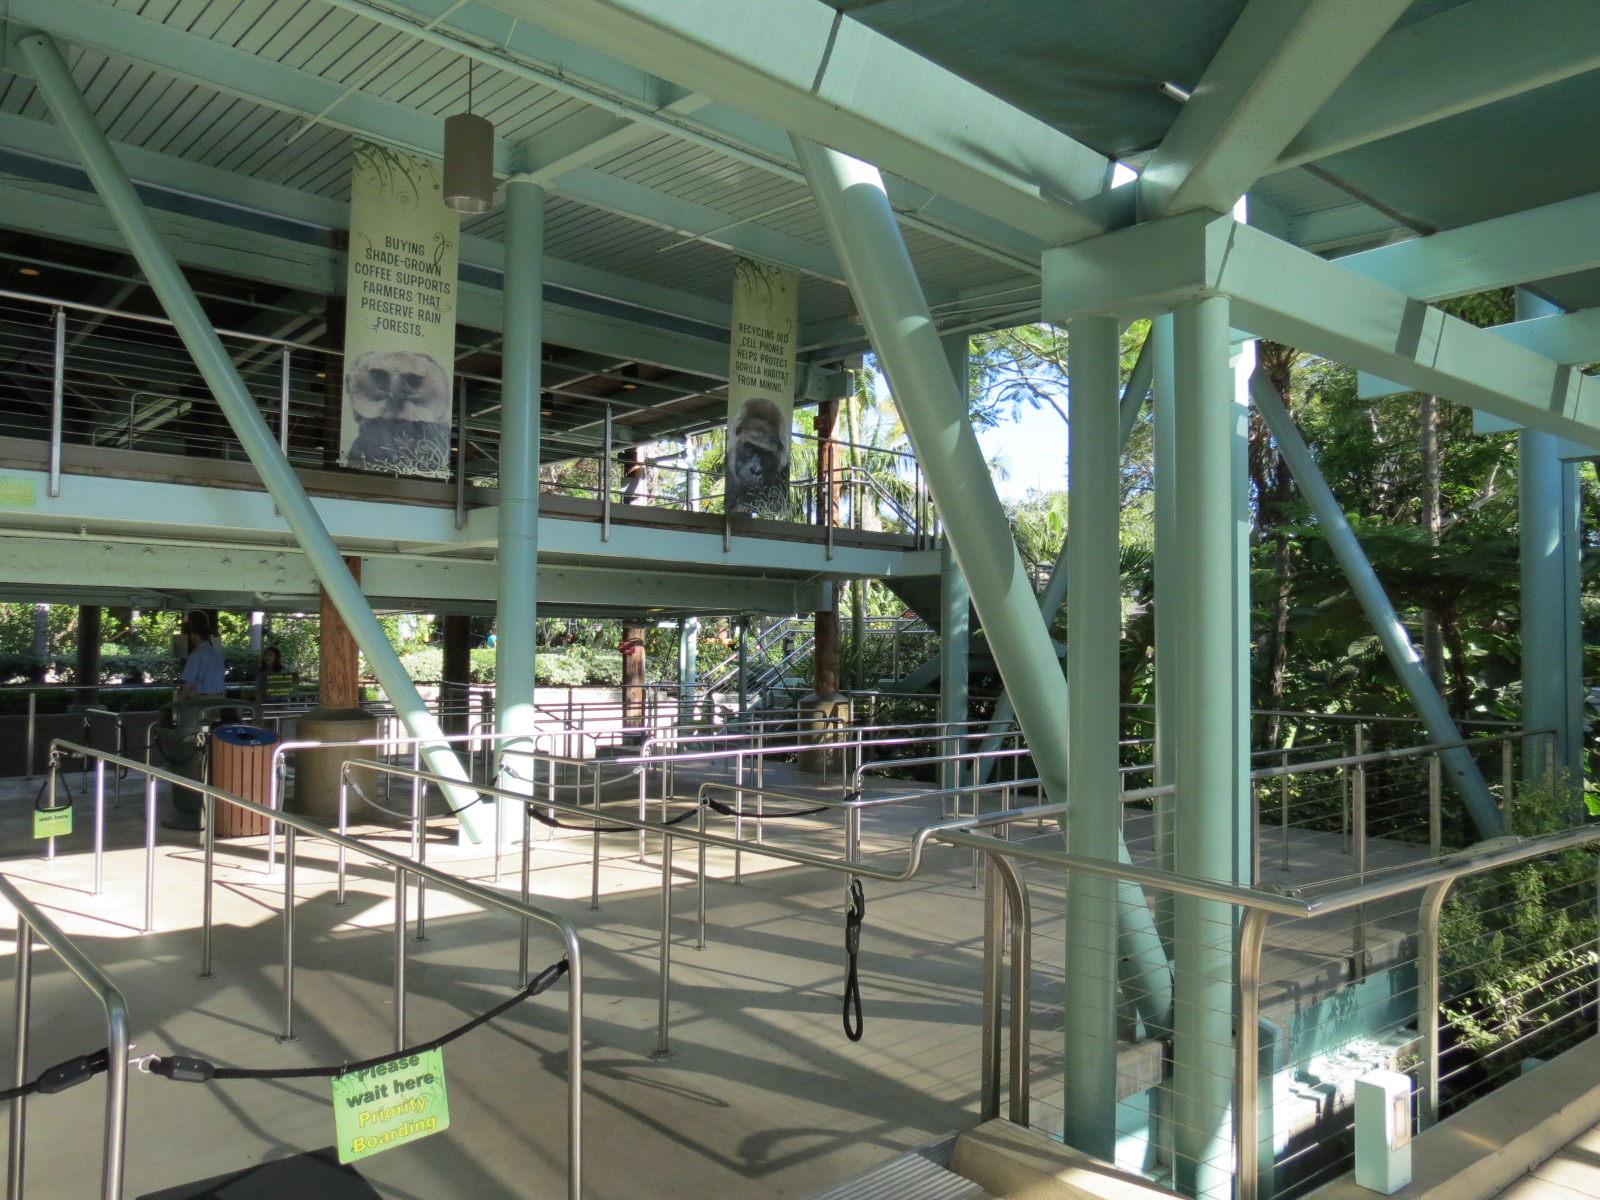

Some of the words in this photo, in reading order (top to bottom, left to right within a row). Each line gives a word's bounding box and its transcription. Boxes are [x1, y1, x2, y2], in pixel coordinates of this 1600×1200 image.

[385, 236, 425, 256] BUYING
[365, 248, 441, 276] SHADE-GROWN
[355, 262, 391, 281] COFFEE
[396, 272, 450, 294] SUPPORTS
[363, 281, 413, 302] FARMERS
[417, 292, 441, 309] THAT
[361, 297, 413, 319] PRESERVE
[418, 309, 441, 324] RAIN
[376, 317, 424, 337] FORESTS.
[738, 323, 774, 340] RECYCLING
[776, 332, 789, 343] OLD
[737, 349, 757, 361] HELPS
[761, 354, 788, 368] PROTECT
[742, 337, 756, 348] CELL
[760, 341, 784, 355] PHONES
[736, 361, 761, 375] GORILLA
[764, 368, 789, 382] HABITAT
[738, 375, 757, 387] FROM
[760, 379, 784, 393] MINING.
[357, 1055, 420, 1082] Please
[346, 1083, 388, 1108] wait
[393, 1072, 435, 1094] here
[358, 1096, 427, 1128] Priority
[352, 1115, 437, 1153] Boarding
